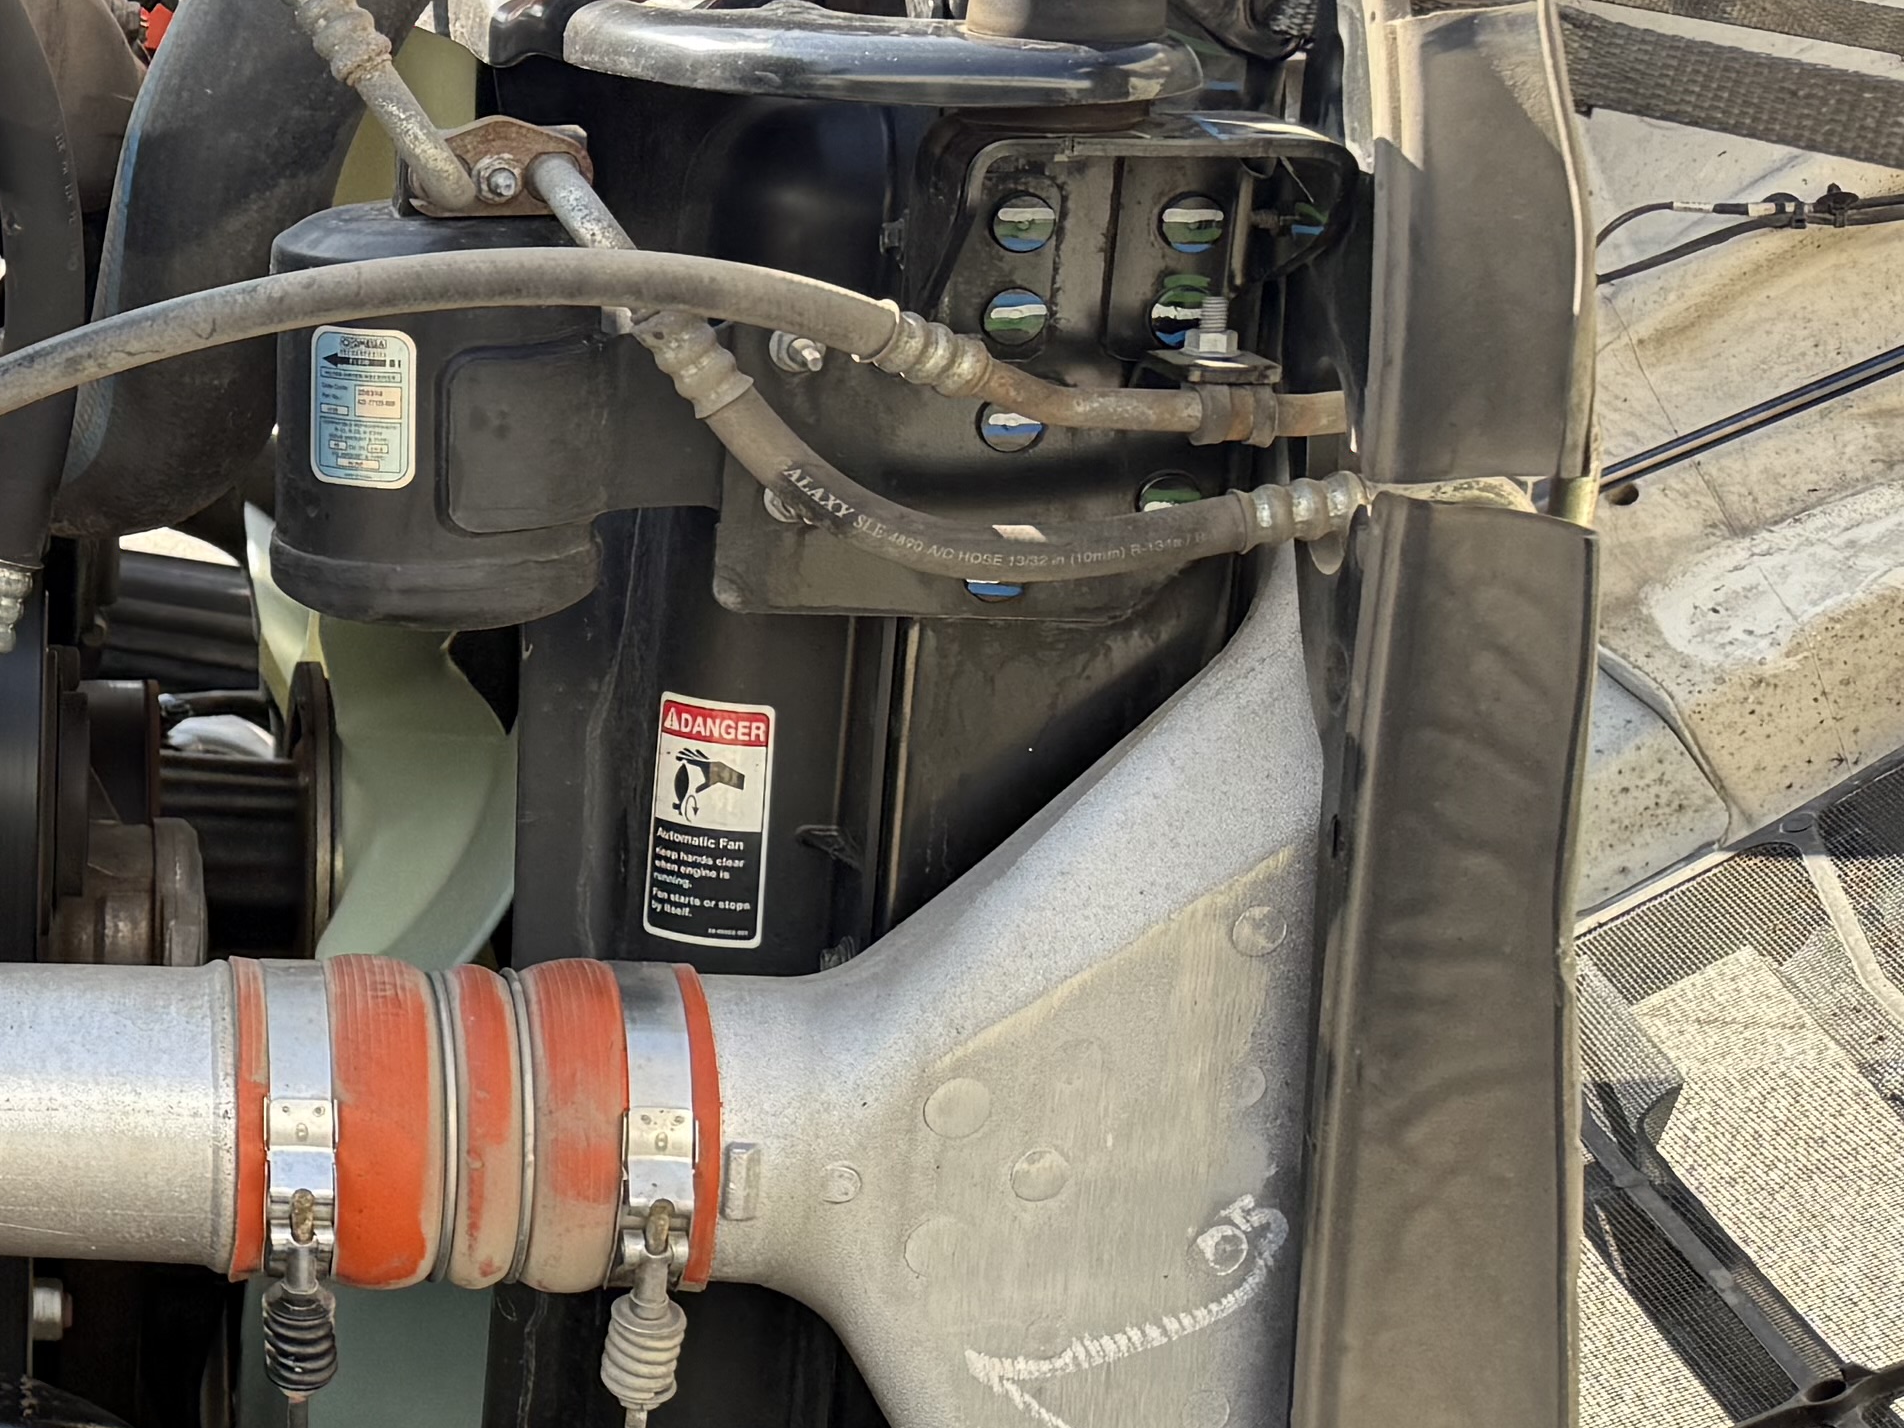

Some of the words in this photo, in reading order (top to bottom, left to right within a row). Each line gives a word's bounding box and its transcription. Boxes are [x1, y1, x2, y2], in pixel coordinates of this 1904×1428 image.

[958, 551, 1004, 567] HOSE
[680, 712, 766, 743] DANGER
[656, 826, 717, 849] Automatic
[719, 837, 745, 851] Fan
[680, 851, 714, 865] hands
[716, 857, 745, 868] clear
[680, 865, 717, 878] engine
[703, 899, 716, 908] or
